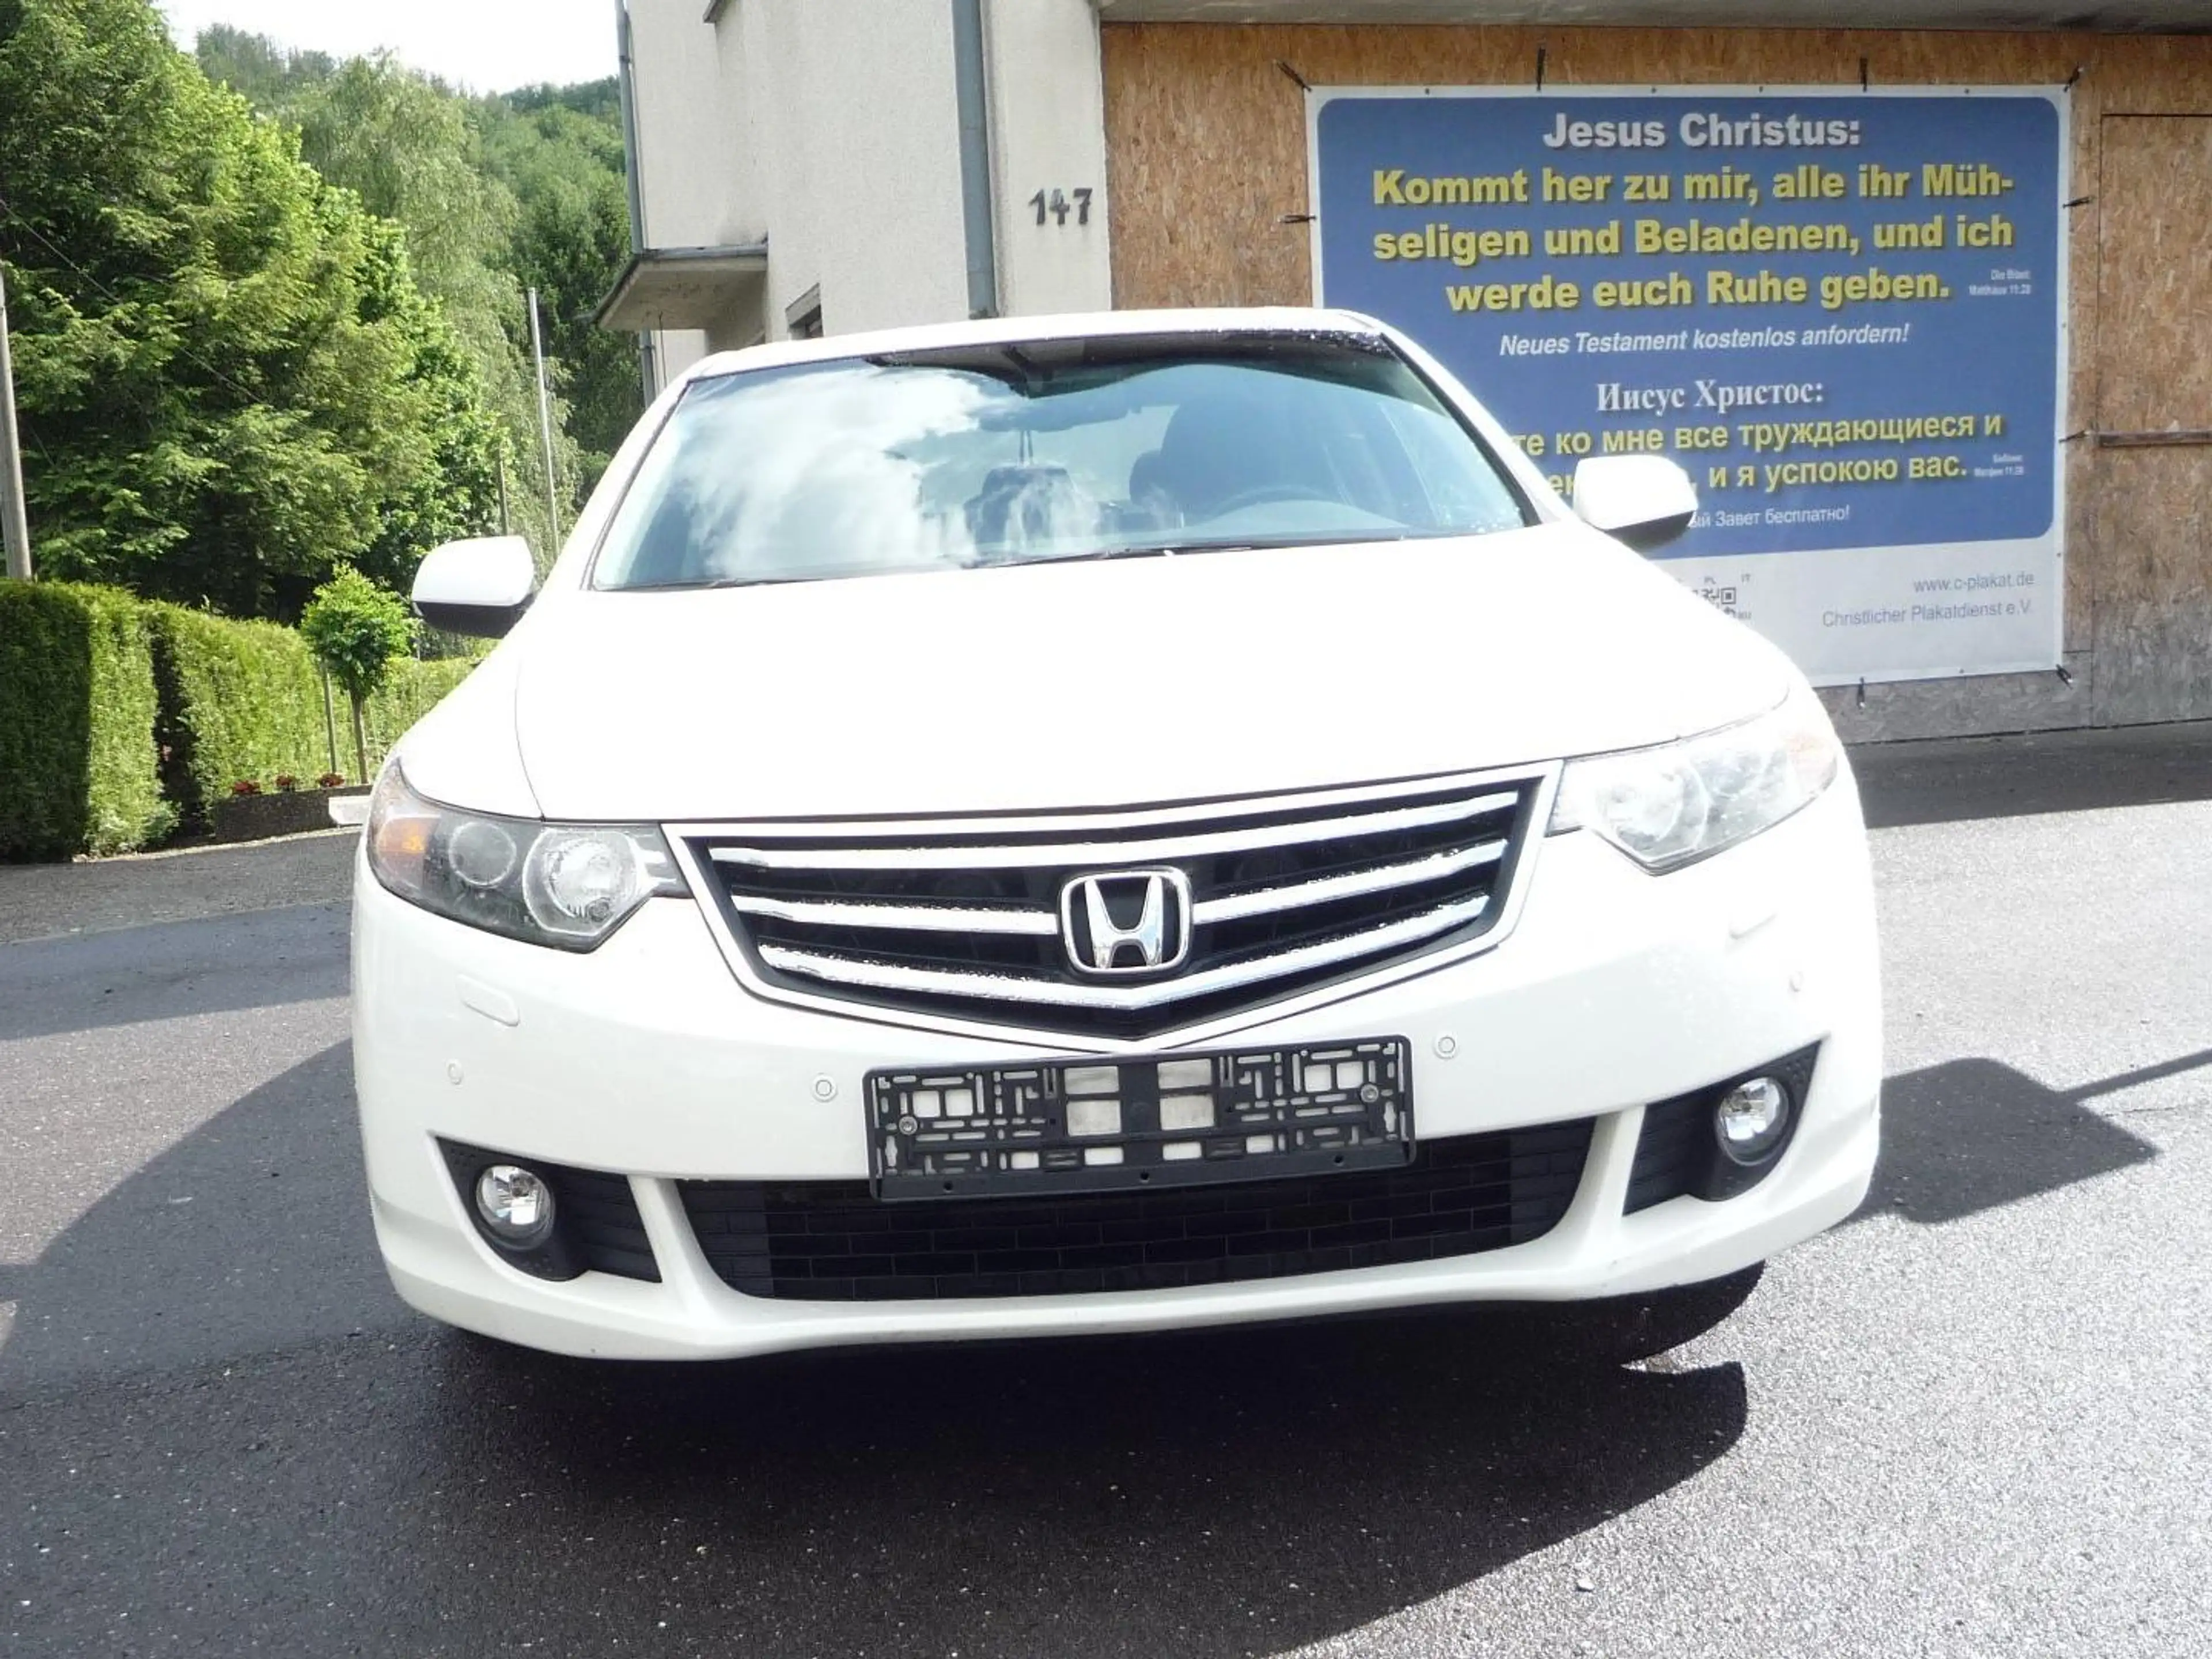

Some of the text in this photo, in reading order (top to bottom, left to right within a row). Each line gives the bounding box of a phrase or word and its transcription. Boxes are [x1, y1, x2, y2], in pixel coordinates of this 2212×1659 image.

[1543, 113, 1859, 147] Jesus Christus:
[1373, 164, 2013, 207] Kommt her zu mir, alle ihr Müh-
[1029, 188, 1093, 226] 147
[1373, 214, 2012, 266] seligen und Beladenen, und ich
[1445, 267, 1949, 311] werde euch Ruhe geben.
[1499, 323, 1910, 356] Neues Testament kostenlos anfordern!
[1597, 380, 1823, 415] Иисус Христос:
[1556, 431, 1591, 454] ко
[1603, 429, 1664, 452] мне
[1674, 426, 1728, 449] все
[1737, 415, 1974, 452] труждающиеся
[1984, 414, 2001, 435] и
[1709, 467, 1726, 488] и
[1737, 465, 1755, 487] я
[1764, 459, 1898, 493] успокою
[1908, 456, 1967, 478] вас.
[1715, 510, 1761, 527] Завет
[1764, 504, 1850, 524] бесплатно!
[1914, 571, 2035, 593] www.c-plakat.de
[1823, 608, 1907, 627] Christlicher
[1911, 602, 2002, 620] Plakatdienst
